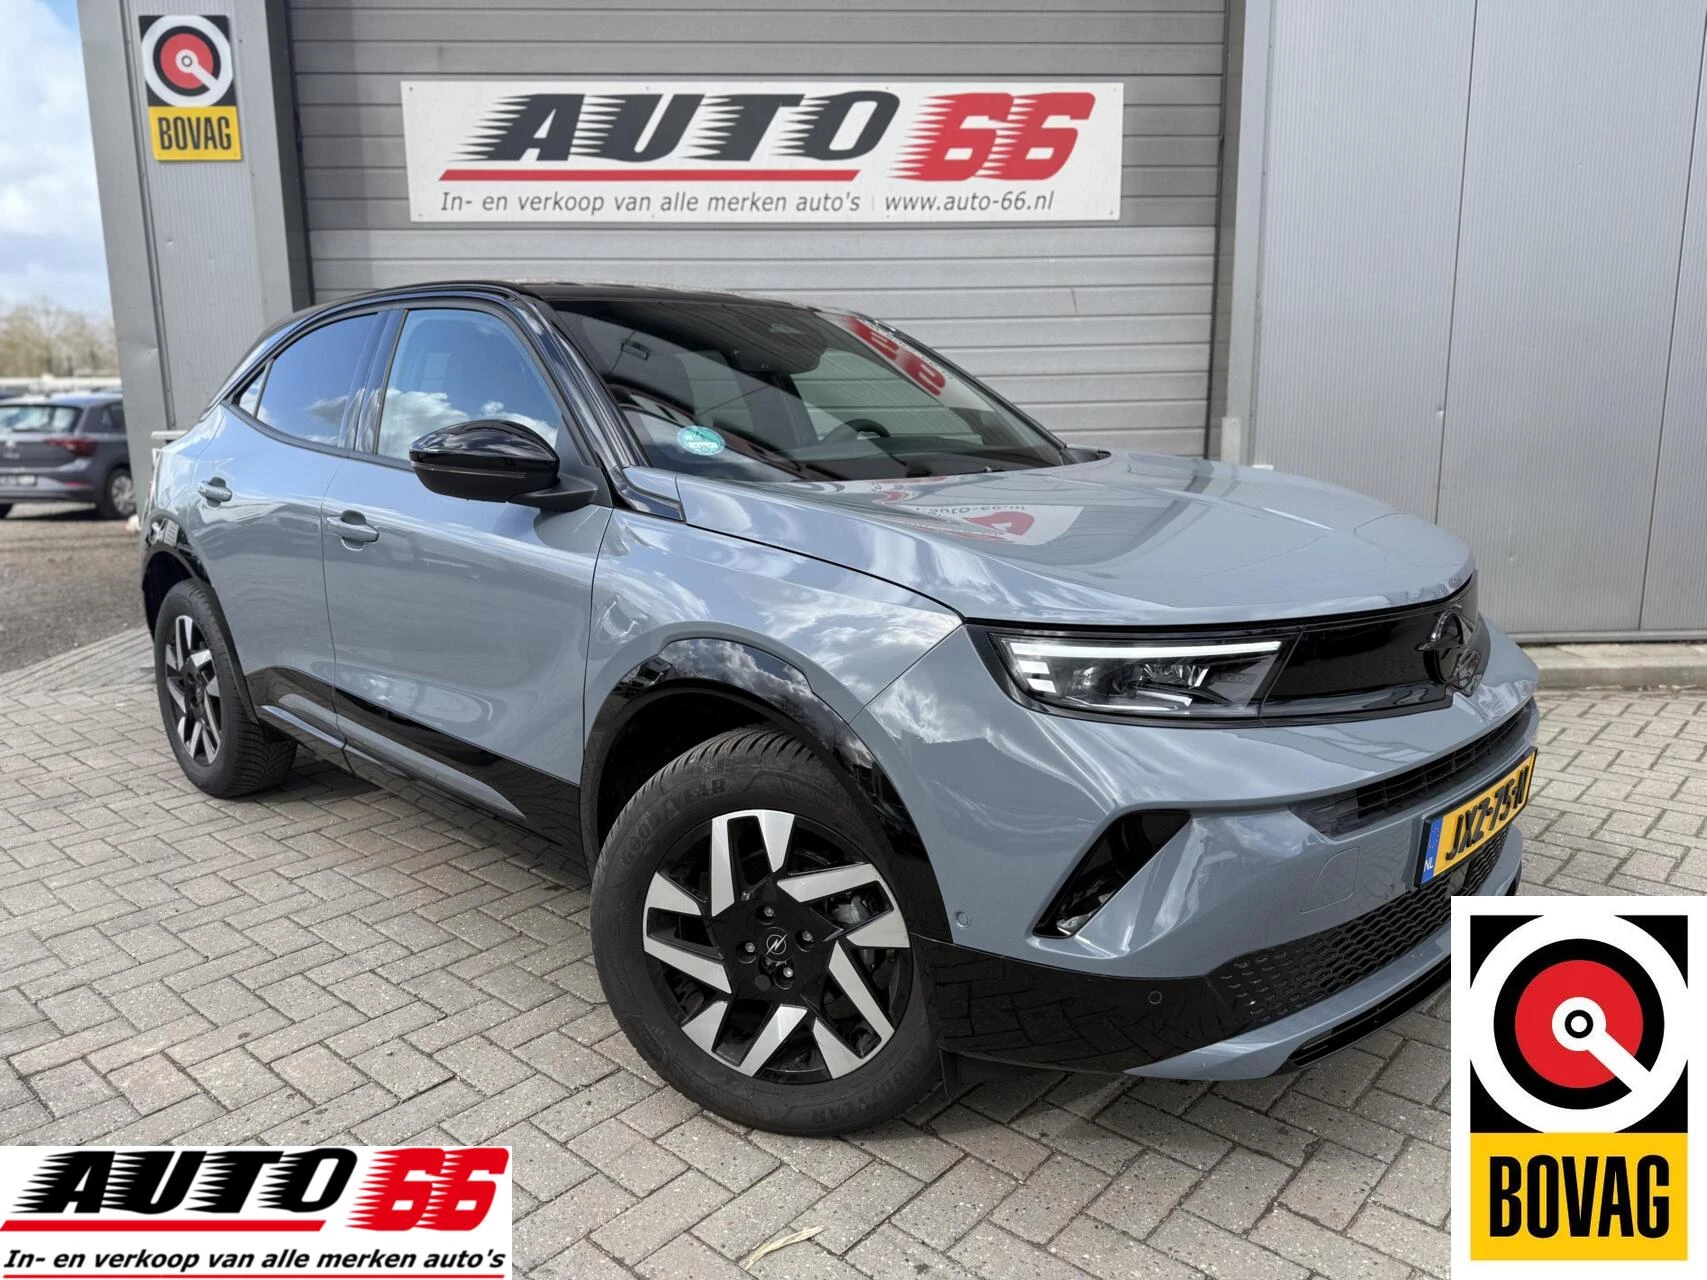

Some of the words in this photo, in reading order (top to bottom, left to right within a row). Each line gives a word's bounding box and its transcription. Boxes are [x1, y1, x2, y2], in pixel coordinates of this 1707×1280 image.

[157, 116, 232, 151] BOVAG
[449, 90, 900, 162] AUTO
[887, 92, 1096, 182] 66
[440, 191, 473, 211] In-
[482, 196, 508, 211] en
[518, 191, 605, 216] verkoop
[614, 196, 651, 211] van
[660, 191, 699, 211] alle
[707, 191, 787, 212] merken
[795, 191, 861, 212] auto's
[885, 190, 1055, 211] www.auto-66.nl
[1423, 857, 1434, 873] NL
